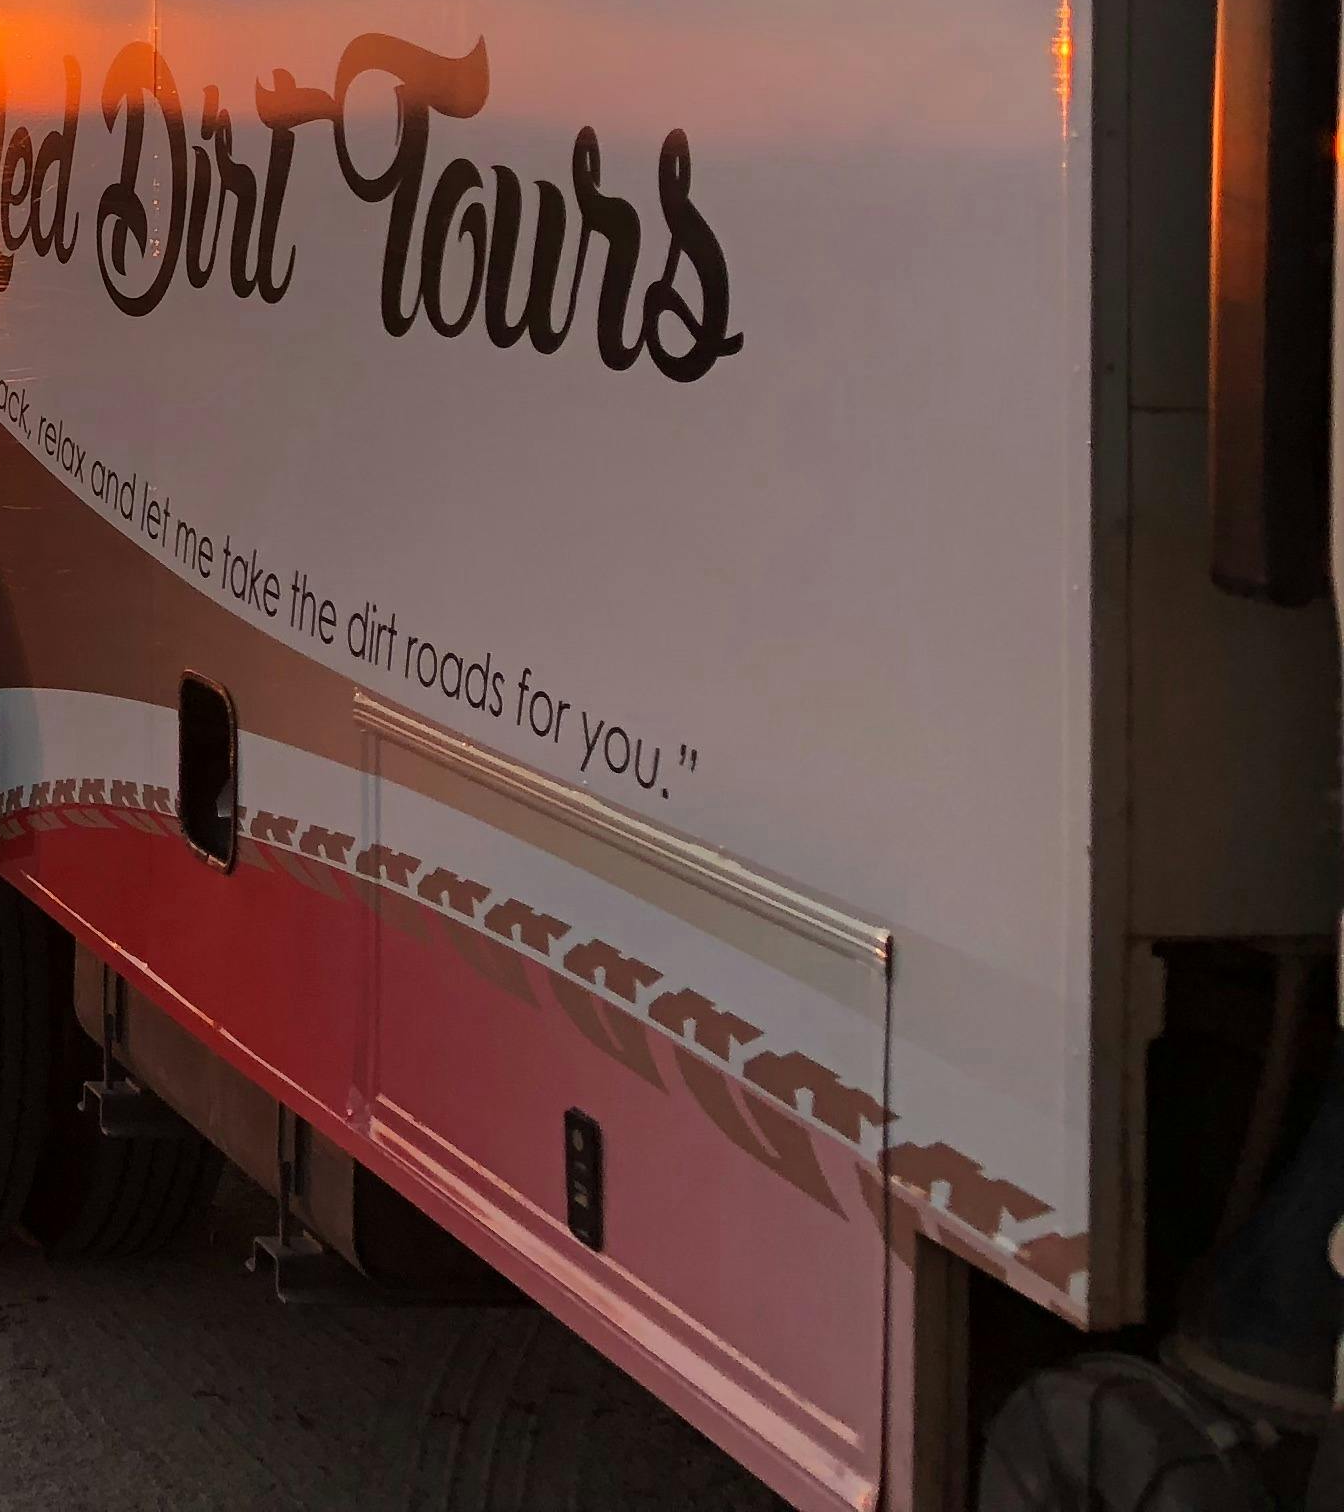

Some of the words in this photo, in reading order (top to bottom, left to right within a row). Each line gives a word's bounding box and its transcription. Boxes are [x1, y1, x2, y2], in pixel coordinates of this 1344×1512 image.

[97, 40, 336, 317] Dirt
[335, 33, 744, 383] Tours
[37, 415, 86, 484] relax
[91, 459, 137, 521] and
[140, 481, 171, 547] let
[175, 518, 213, 578] me
[221, 535, 280, 617] take
[289, 570, 337, 645] the
[347, 601, 398, 671] dirt
[404, 635, 505, 718] roads
[516, 667, 571, 743] for
